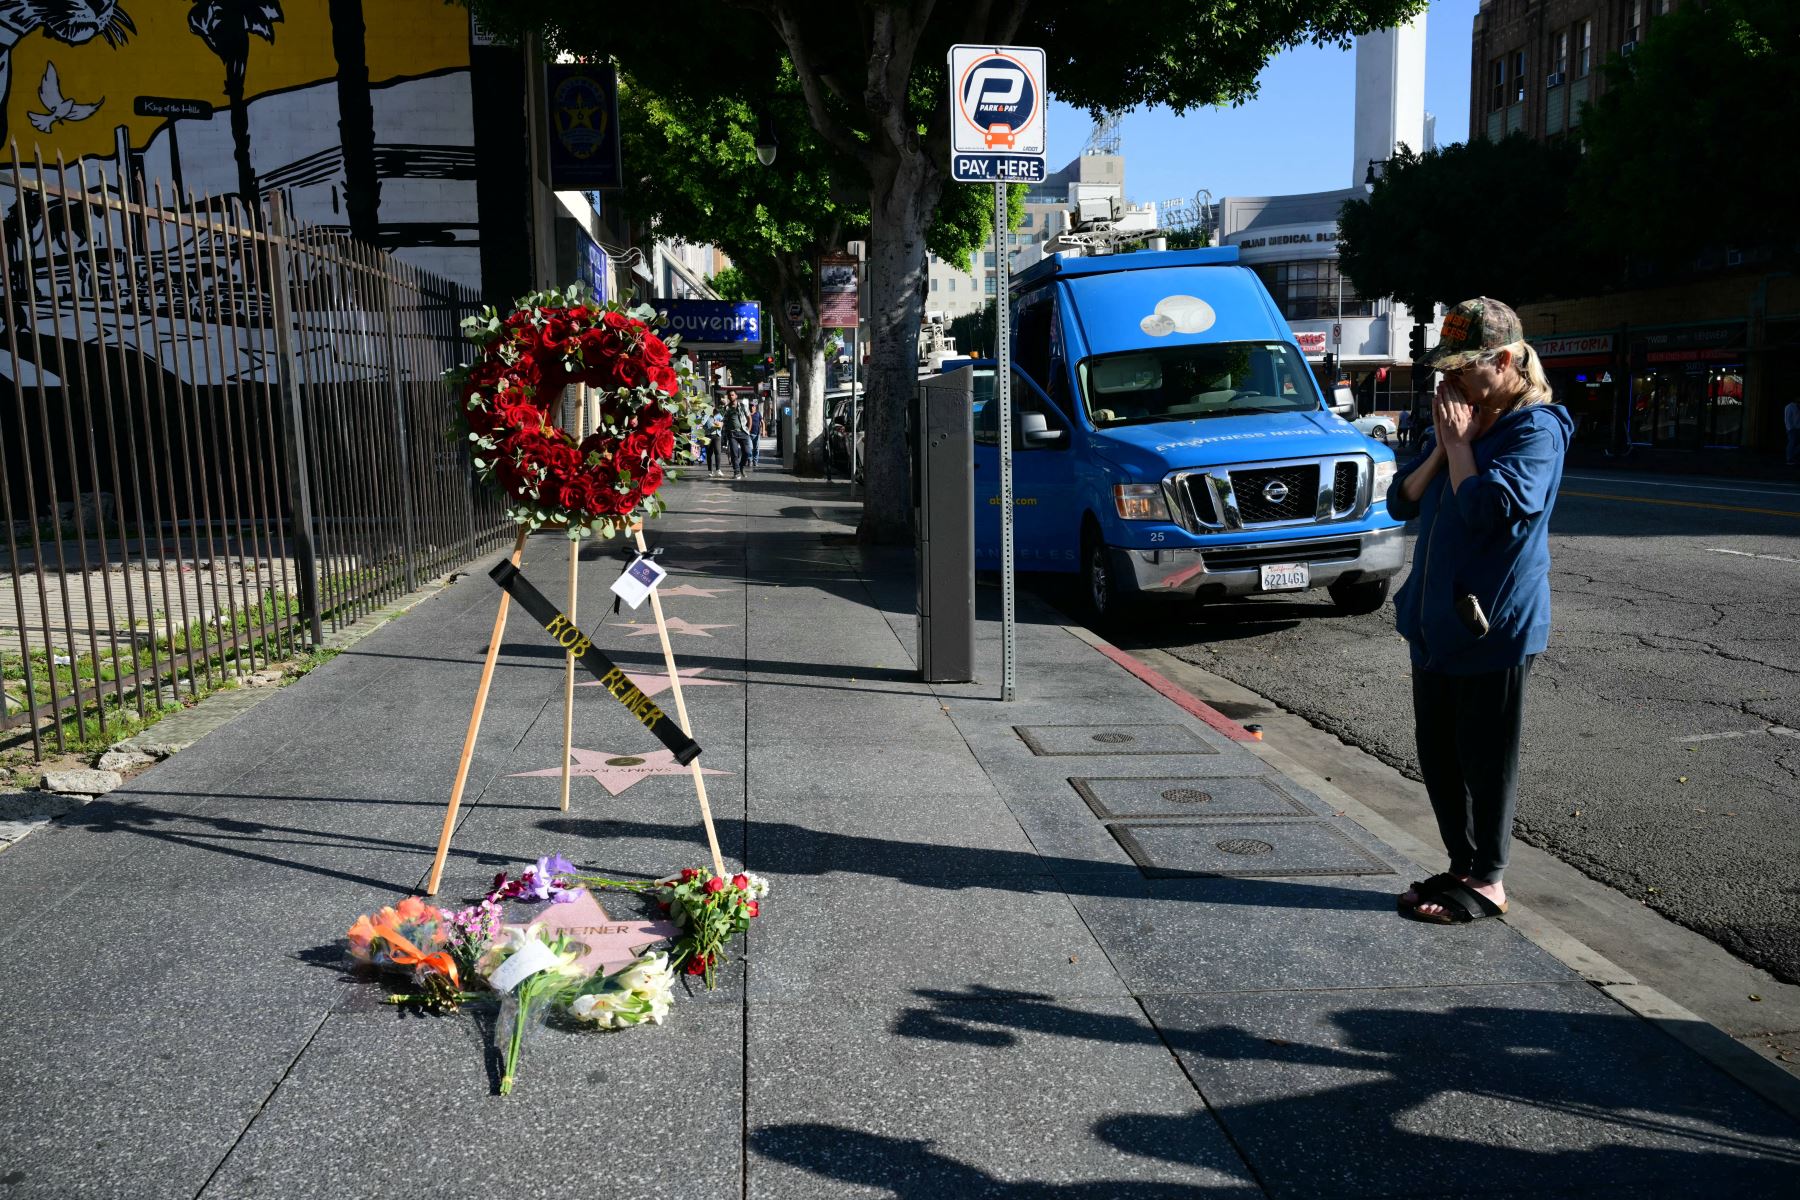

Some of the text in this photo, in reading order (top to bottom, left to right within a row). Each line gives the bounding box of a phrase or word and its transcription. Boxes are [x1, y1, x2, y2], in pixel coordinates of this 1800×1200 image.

[965, 67, 1025, 120] P
[960, 159, 989, 175] PAY
[997, 160, 1039, 177] HERE
[1268, 233, 1313, 246] MEDICAL
[1543, 337, 1608, 352] TRATTORIA
[1155, 432, 1266, 452] EYEWITNESS
[1150, 532, 1165, 542] 25
[975, 547, 1076, 560] ANELES
[1264, 572, 1306, 586] 62214G1
[545, 613, 665, 730] ROB REINER
[555, 925, 629, 936] REINER
